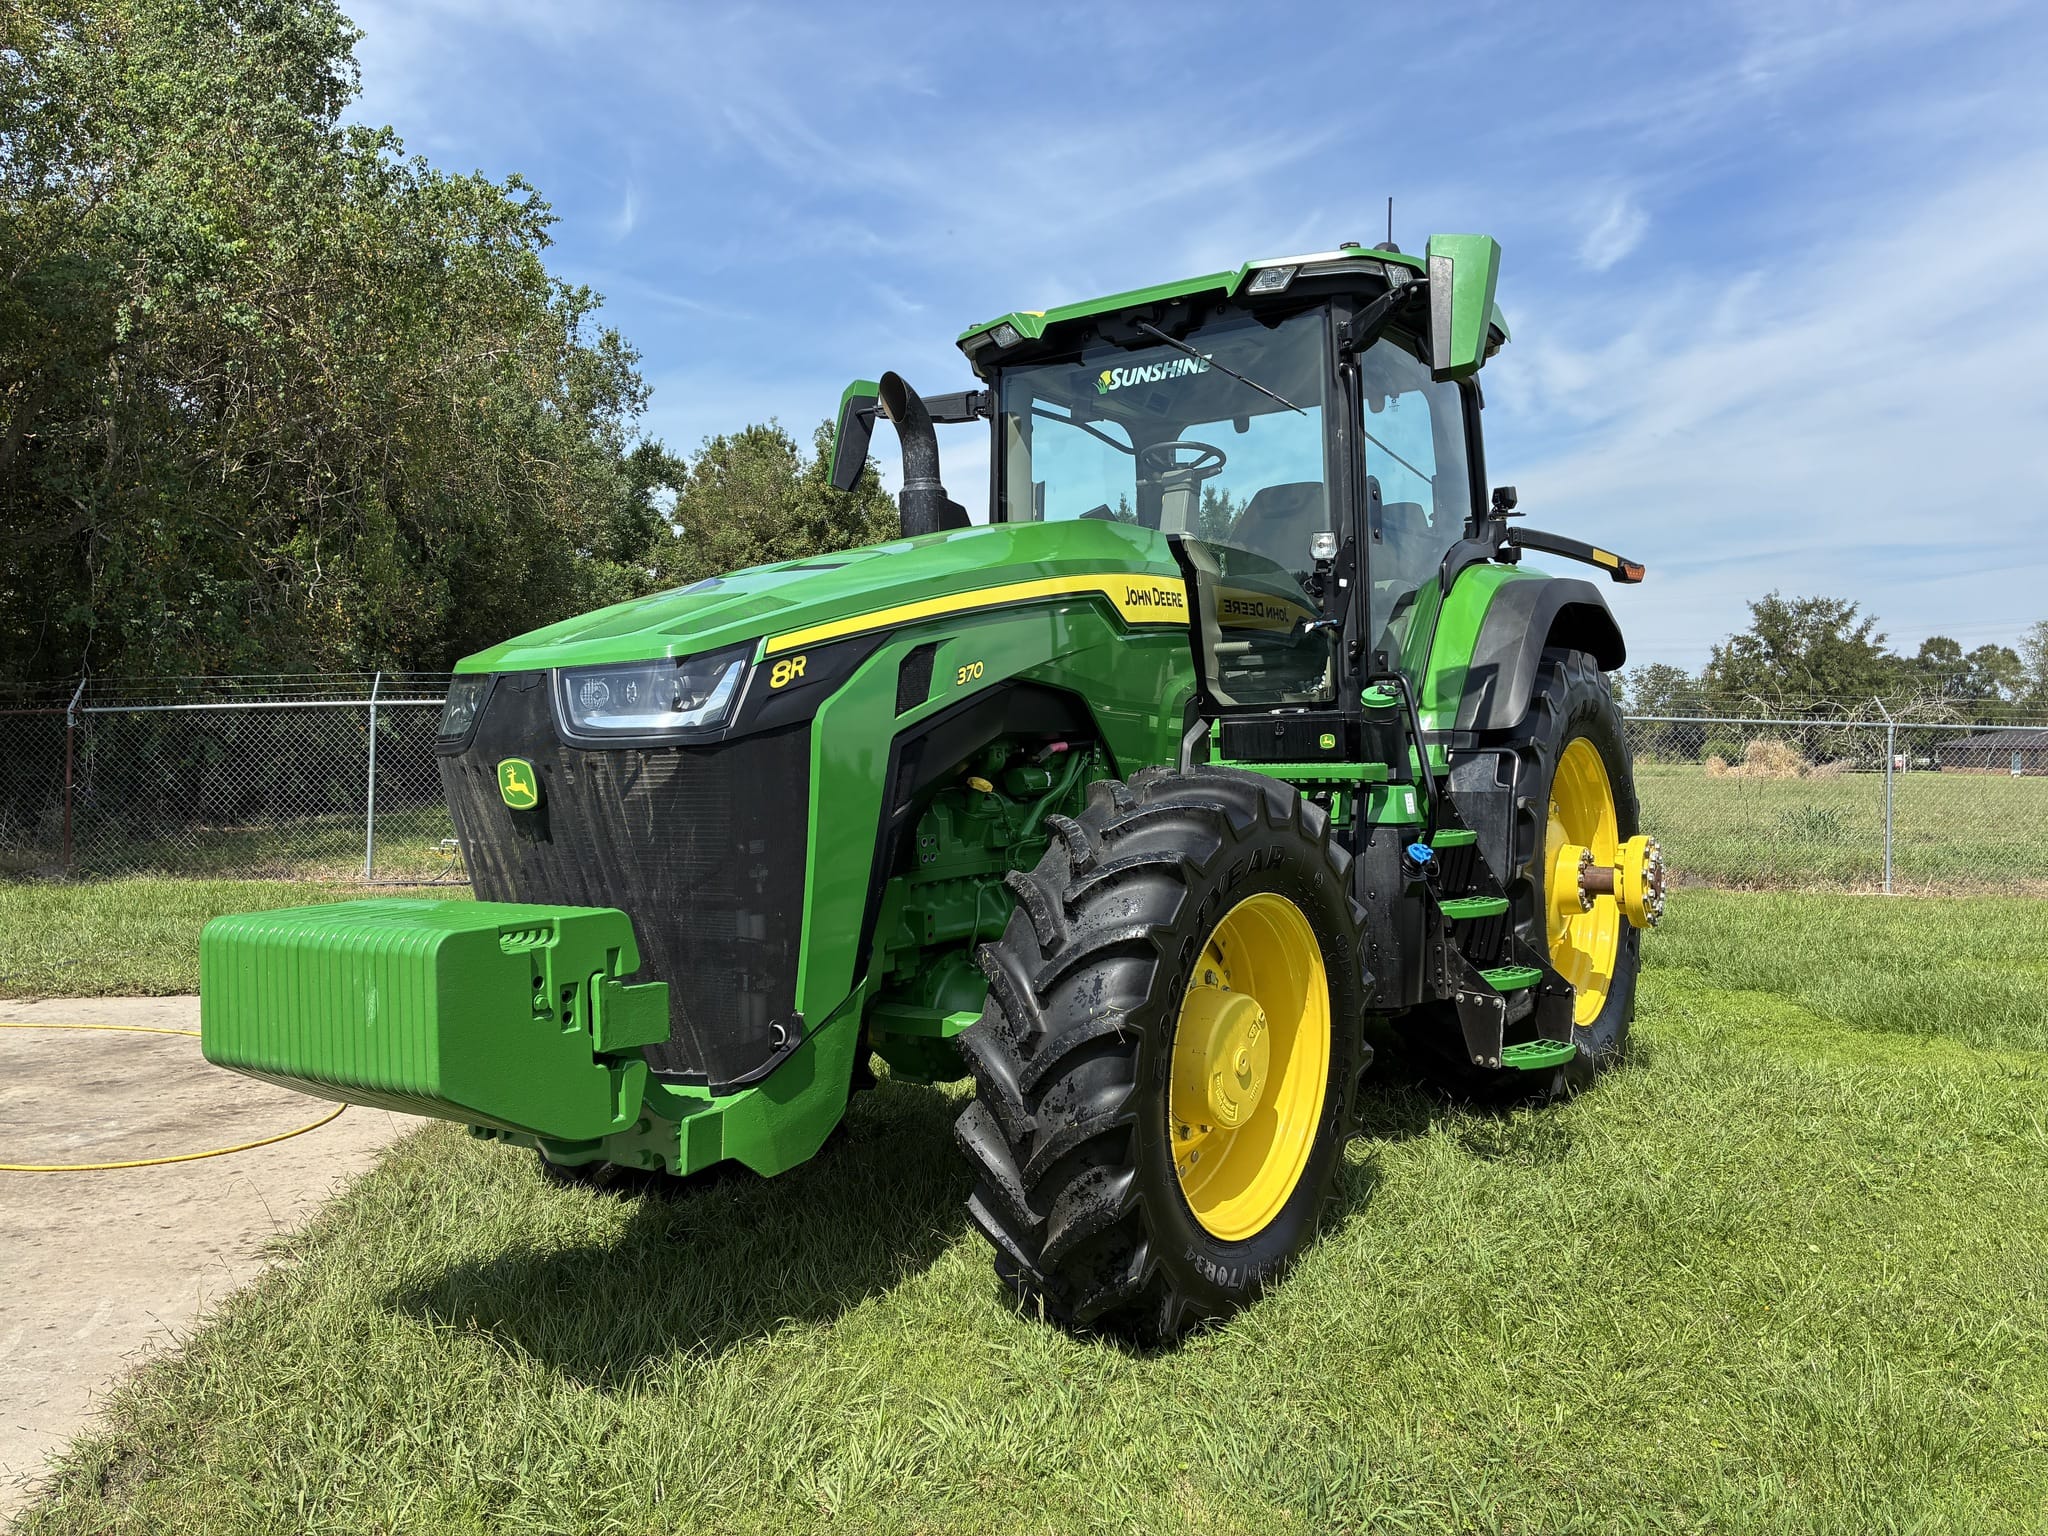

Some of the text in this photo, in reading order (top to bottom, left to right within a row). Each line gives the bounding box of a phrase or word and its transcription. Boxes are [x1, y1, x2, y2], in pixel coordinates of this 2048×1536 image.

[1125, 586, 1184, 608] JOHN DEERE
[769, 655, 807, 689] 8R
[956, 661, 984, 686] 370
